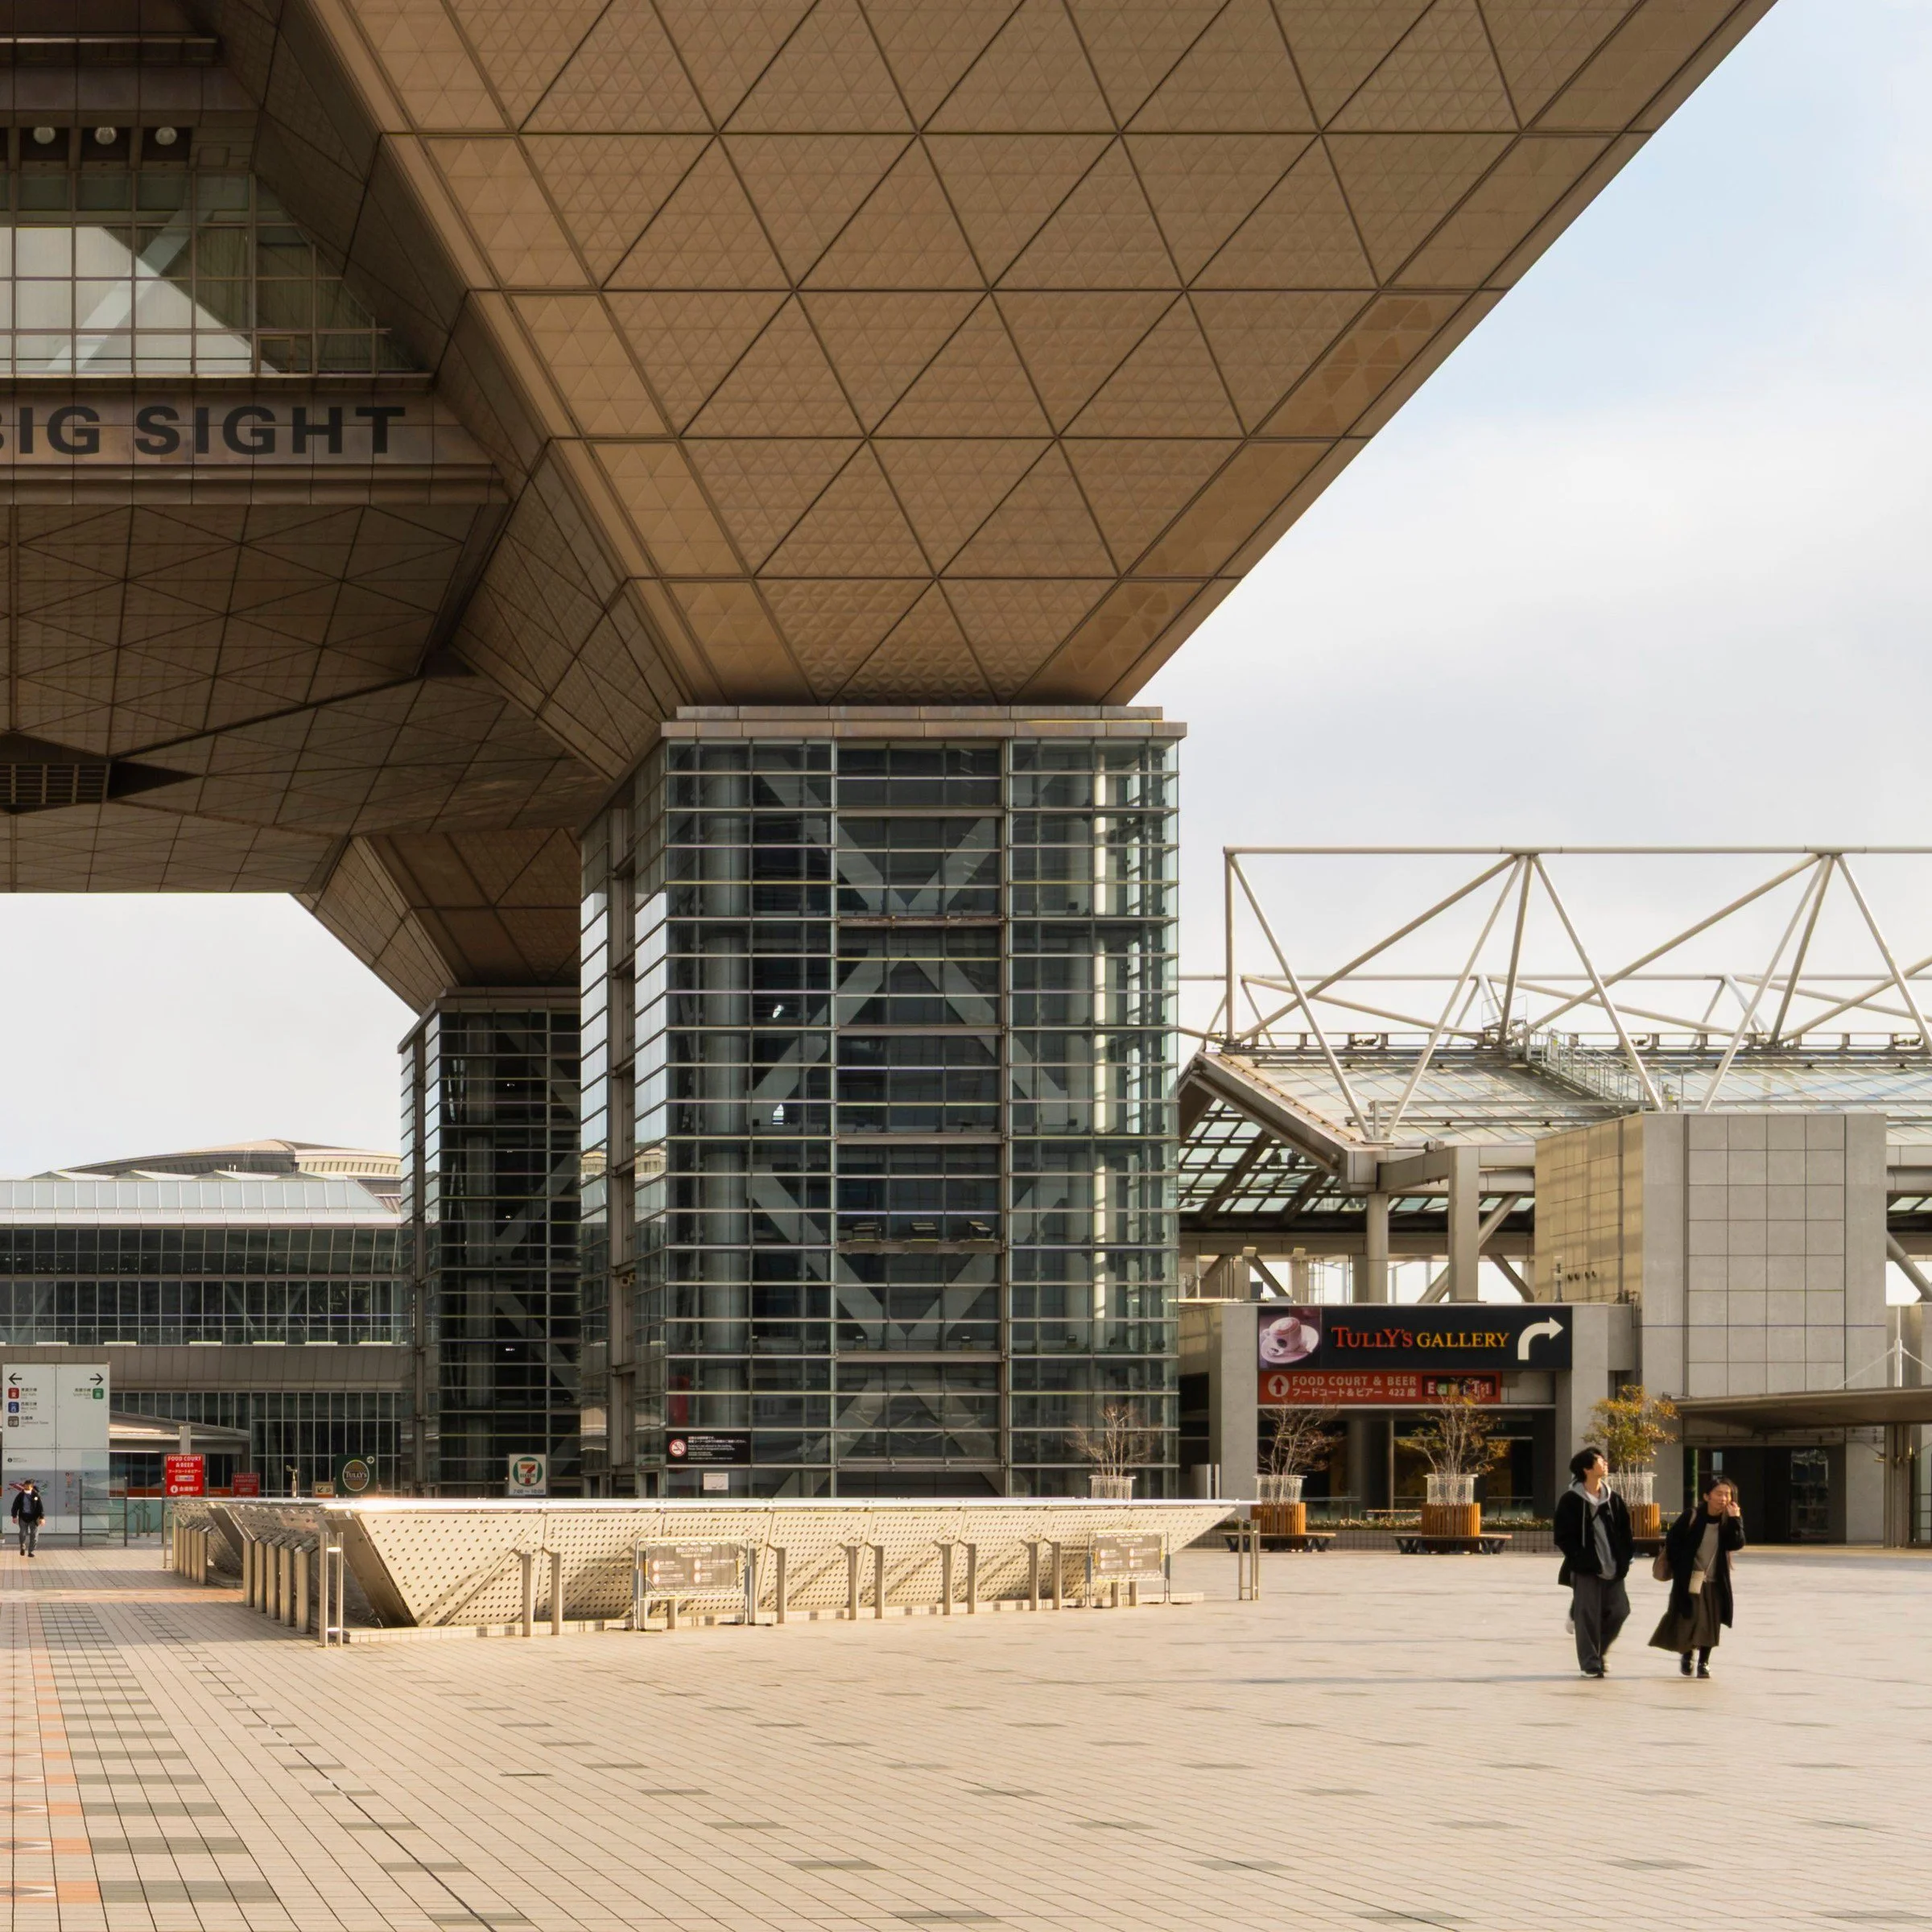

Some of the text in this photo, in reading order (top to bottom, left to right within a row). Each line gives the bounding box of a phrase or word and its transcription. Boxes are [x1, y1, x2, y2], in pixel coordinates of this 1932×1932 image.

[0, 406, 406, 455] IG SIGHT
[1331, 1327, 1509, 1348] TULLY'S GALLERY
[1292, 1376, 1417, 1386] FOOD COURT & BEER
